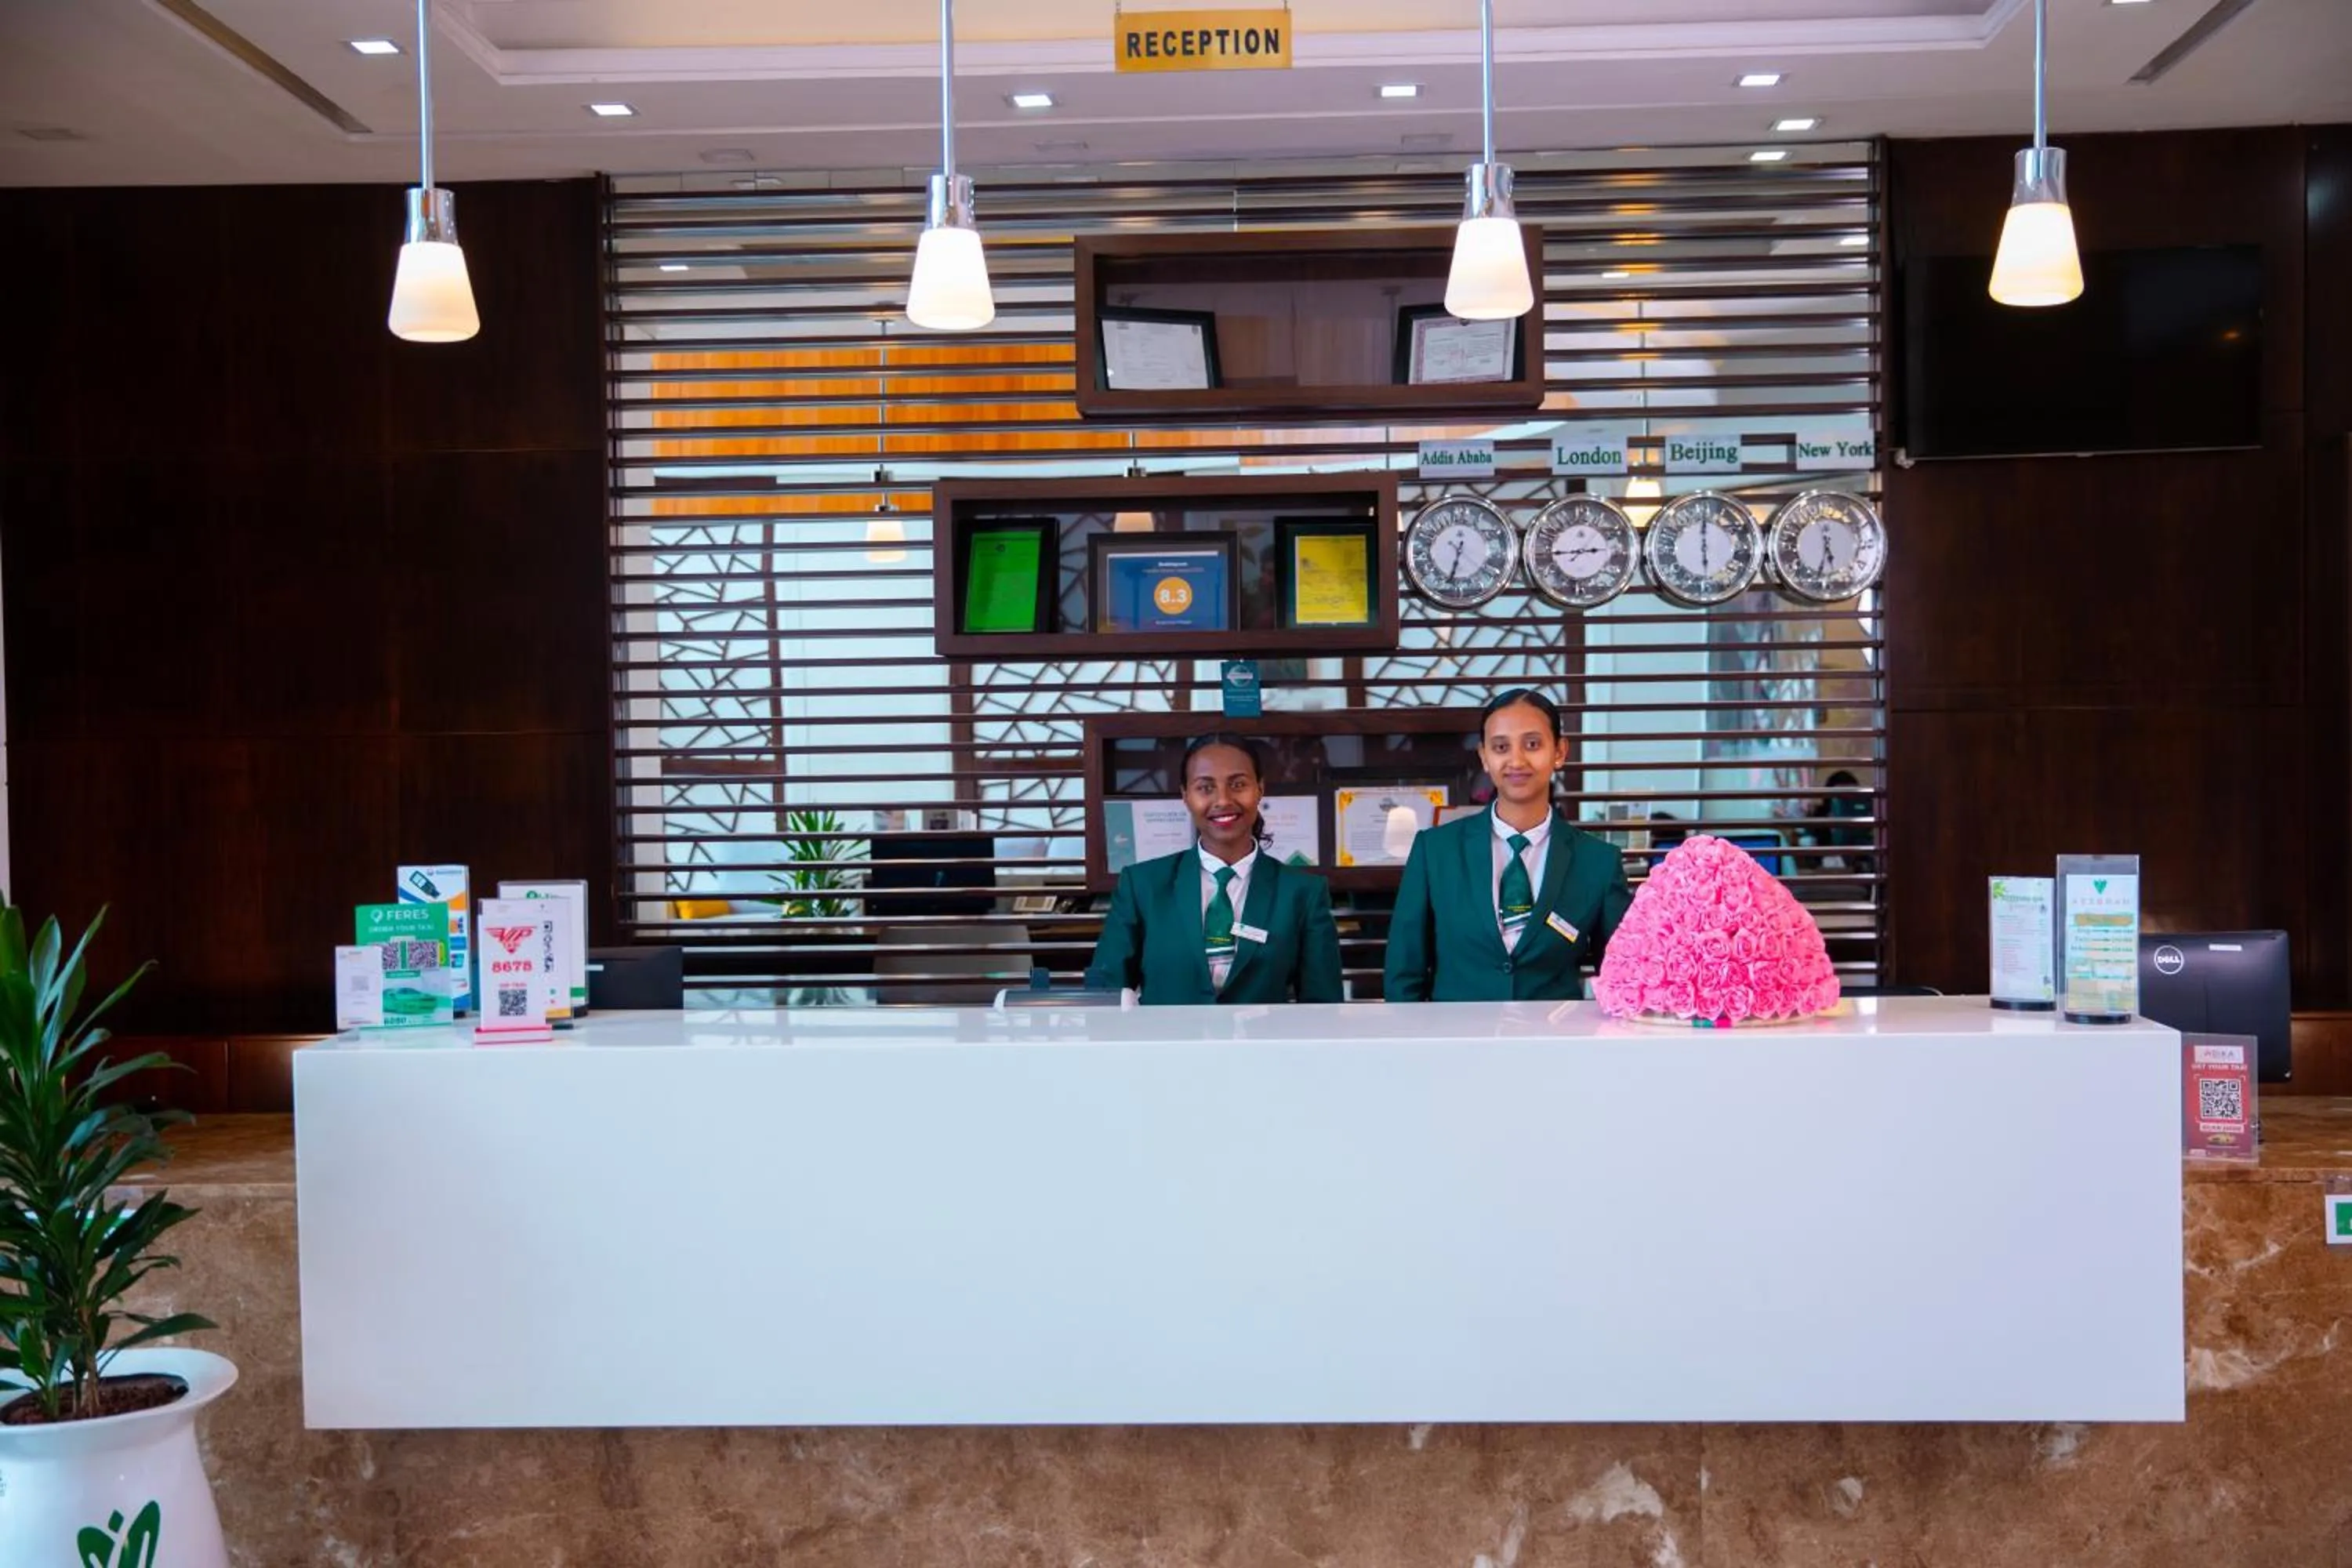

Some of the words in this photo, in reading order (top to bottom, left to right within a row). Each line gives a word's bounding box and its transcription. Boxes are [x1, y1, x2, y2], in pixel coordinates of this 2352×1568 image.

[1126, 28, 1279, 58] RECEPTION
[1421, 450, 1454, 465] Addis
[1457, 449, 1493, 465] Ababa
[1557, 446, 1622, 465] London
[1670, 442, 1737, 464] Beijing
[1798, 443, 1831, 458] New
[1836, 441, 1873, 457] York
[1160, 589, 1187, 603] 8.3
[387, 909, 429, 920] FERES
